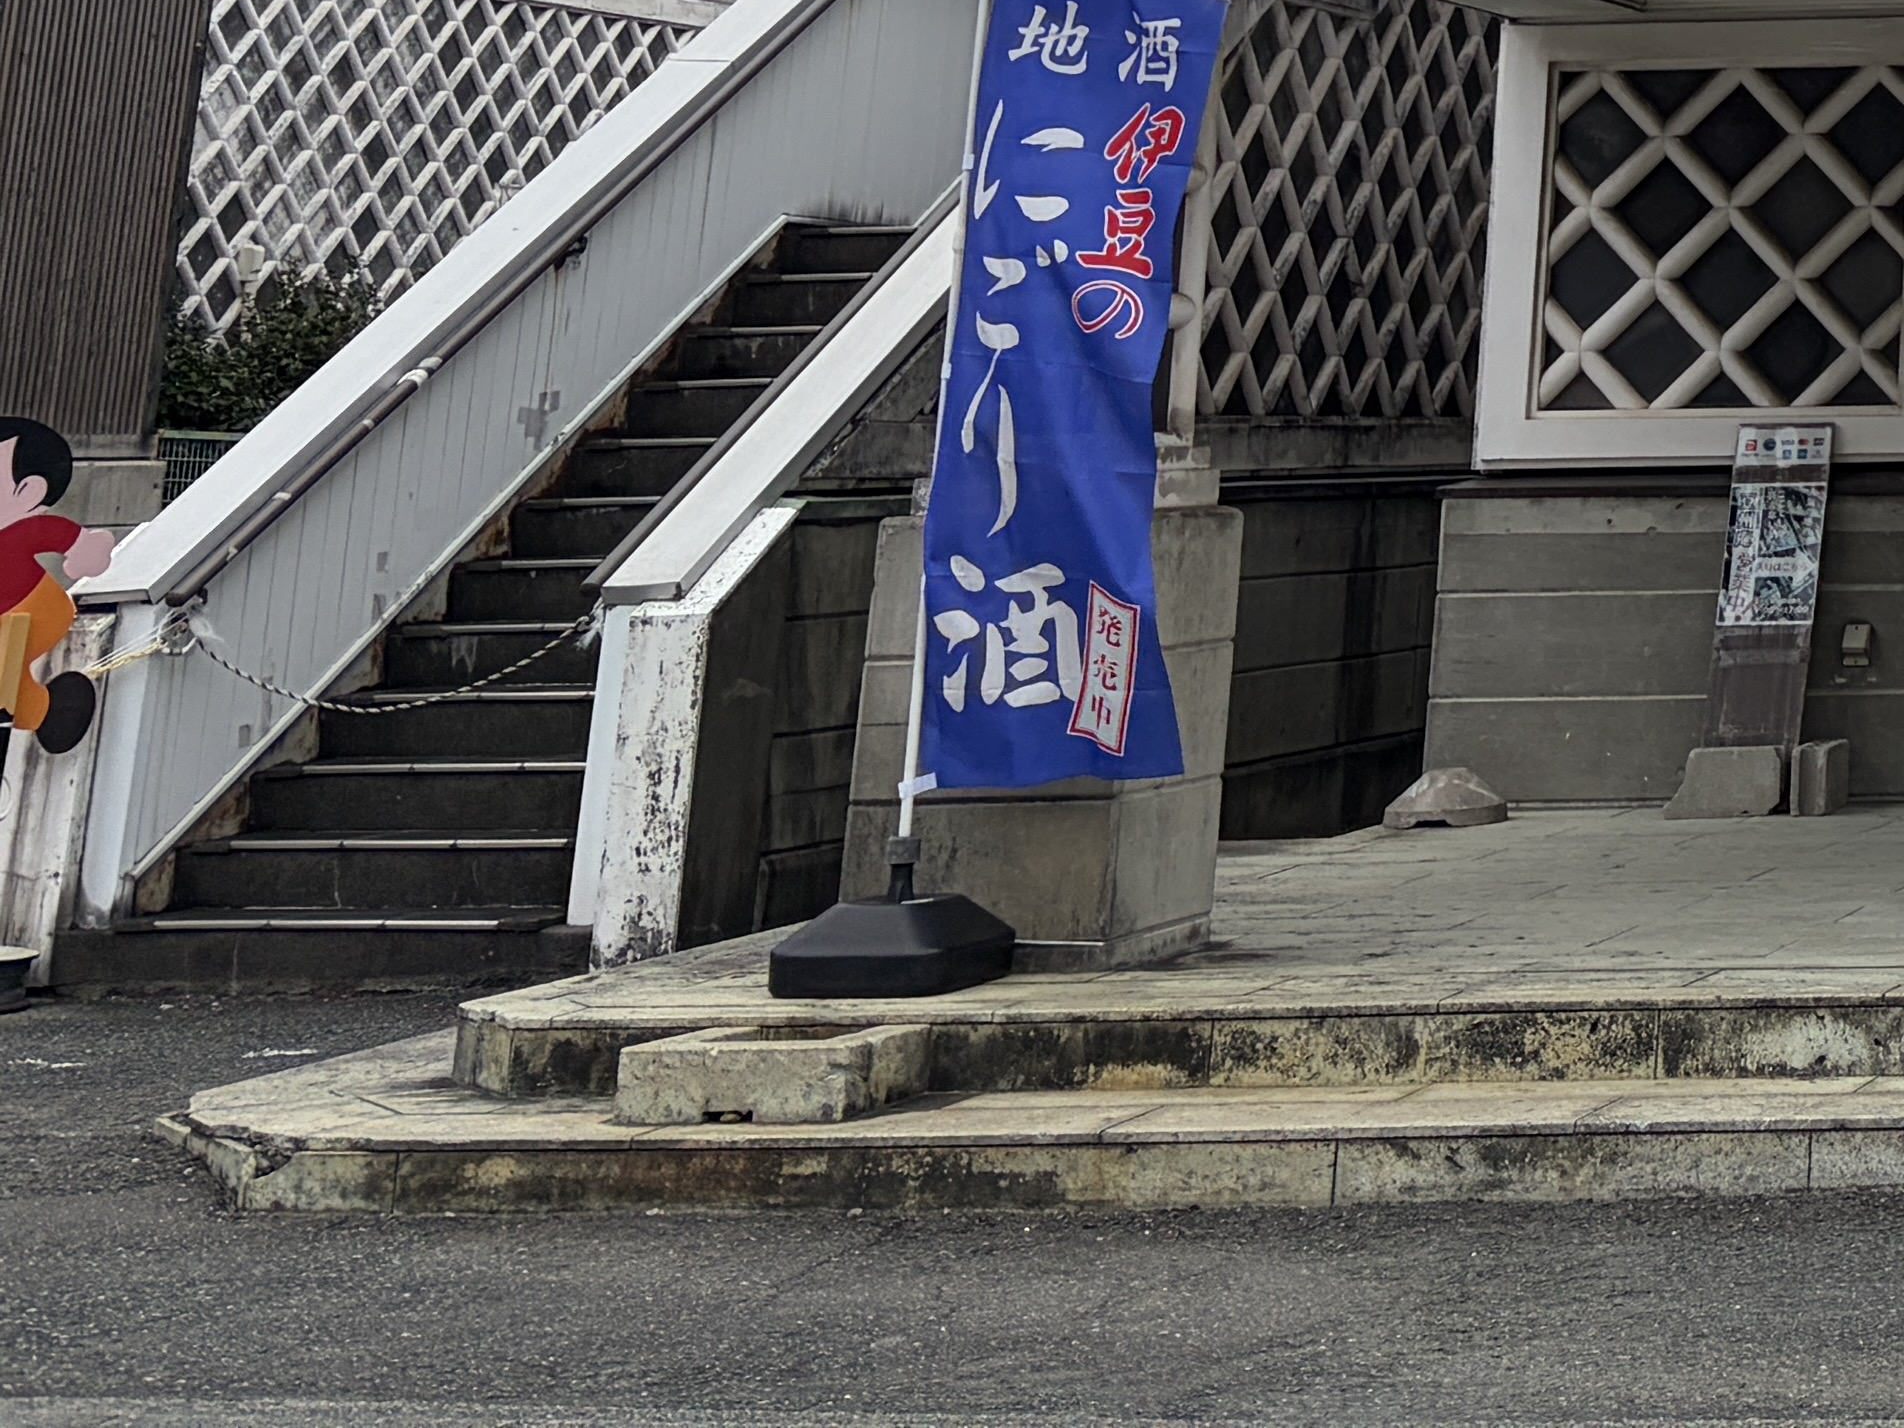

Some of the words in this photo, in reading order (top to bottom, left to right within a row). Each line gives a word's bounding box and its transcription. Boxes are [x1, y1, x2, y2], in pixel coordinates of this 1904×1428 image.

[1071, 101, 1187, 340] 伊豆の
[933, 97, 1086, 714] にごり酒
[1092, 604, 1124, 732] 発売中
